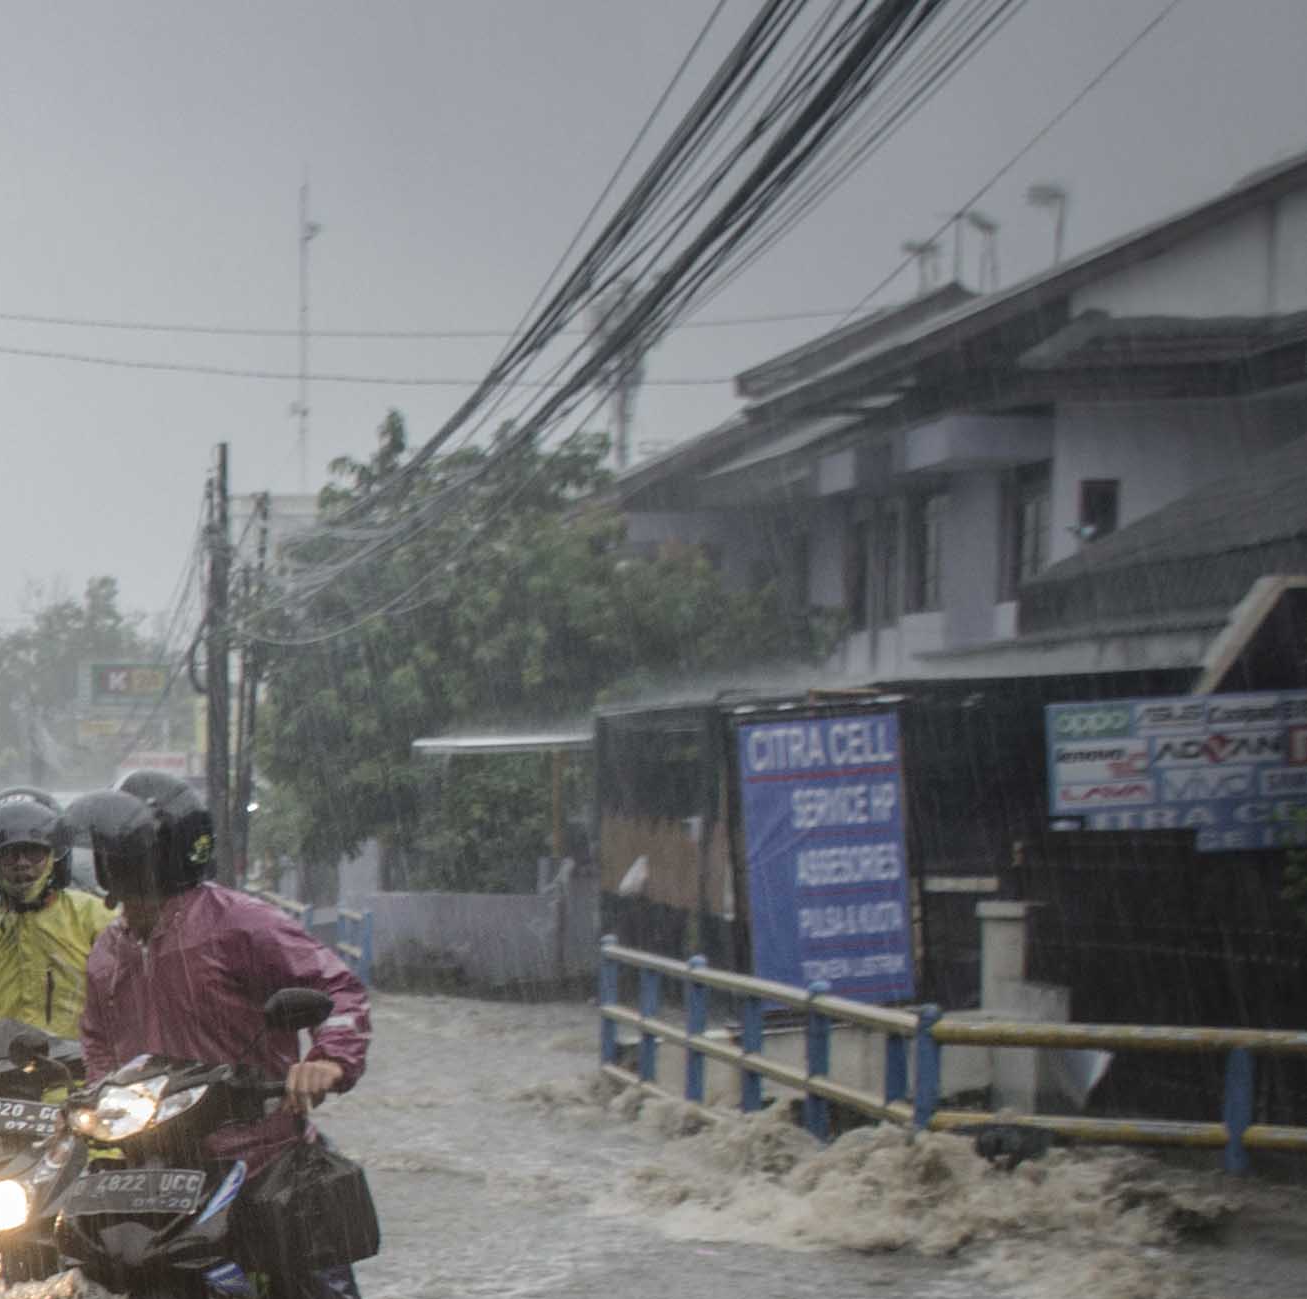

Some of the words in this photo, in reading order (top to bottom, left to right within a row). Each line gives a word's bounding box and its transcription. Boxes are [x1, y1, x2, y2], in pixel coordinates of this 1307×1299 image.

[748, 725, 825, 772] CITRA
[828, 721, 896, 766] CELL
[97, 1175, 146, 1193] 4822
[159, 1174, 200, 1193] UCC
